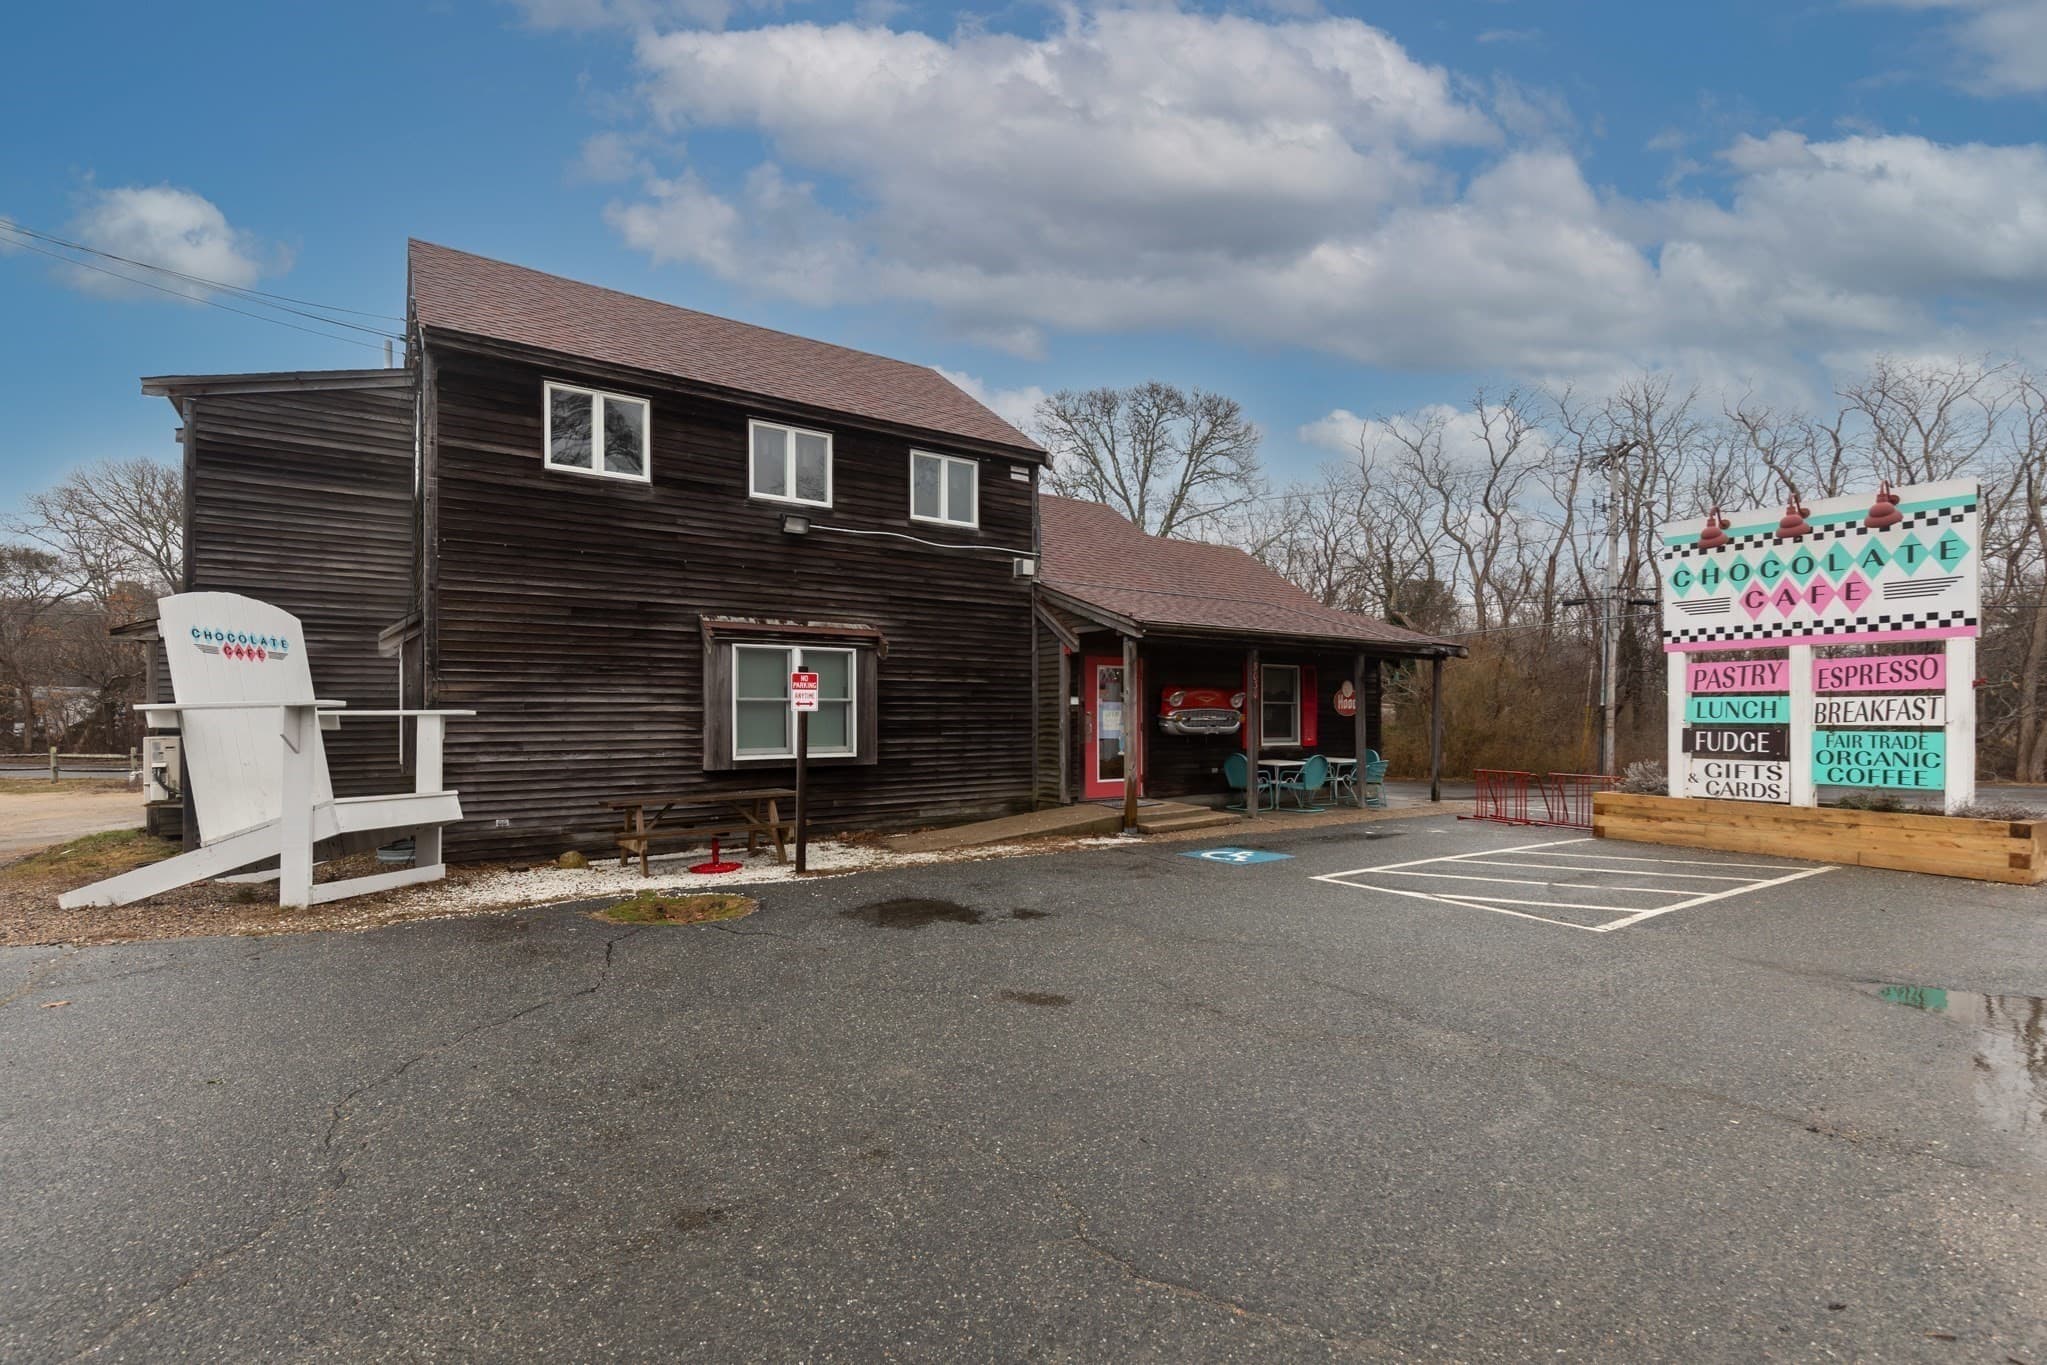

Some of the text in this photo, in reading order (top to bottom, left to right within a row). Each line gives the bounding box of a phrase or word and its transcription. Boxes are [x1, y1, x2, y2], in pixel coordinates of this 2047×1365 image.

[1673, 538, 1959, 588] CHOCOLATE
[1745, 580, 1862, 609] CAFE
[191, 628, 288, 649] CHOCOLATE
[223, 646, 265, 659] CAFE
[1693, 662, 1783, 690] PASTRY
[1818, 657, 1938, 689] ESPRESSO
[1696, 700, 1777, 719] LUNCH
[1814, 696, 1942, 724] BREAKFAST
[1695, 731, 1770, 753] FUDGE
[1826, 734, 1929, 750] FAIR TRADE
[1815, 750, 1941, 769] ORGANIC
[1688, 773, 1699, 784] &
[1704, 762, 1783, 782] GIFTS
[1827, 767, 1929, 787] COFFEE
[1706, 780, 1781, 800] CARDS
